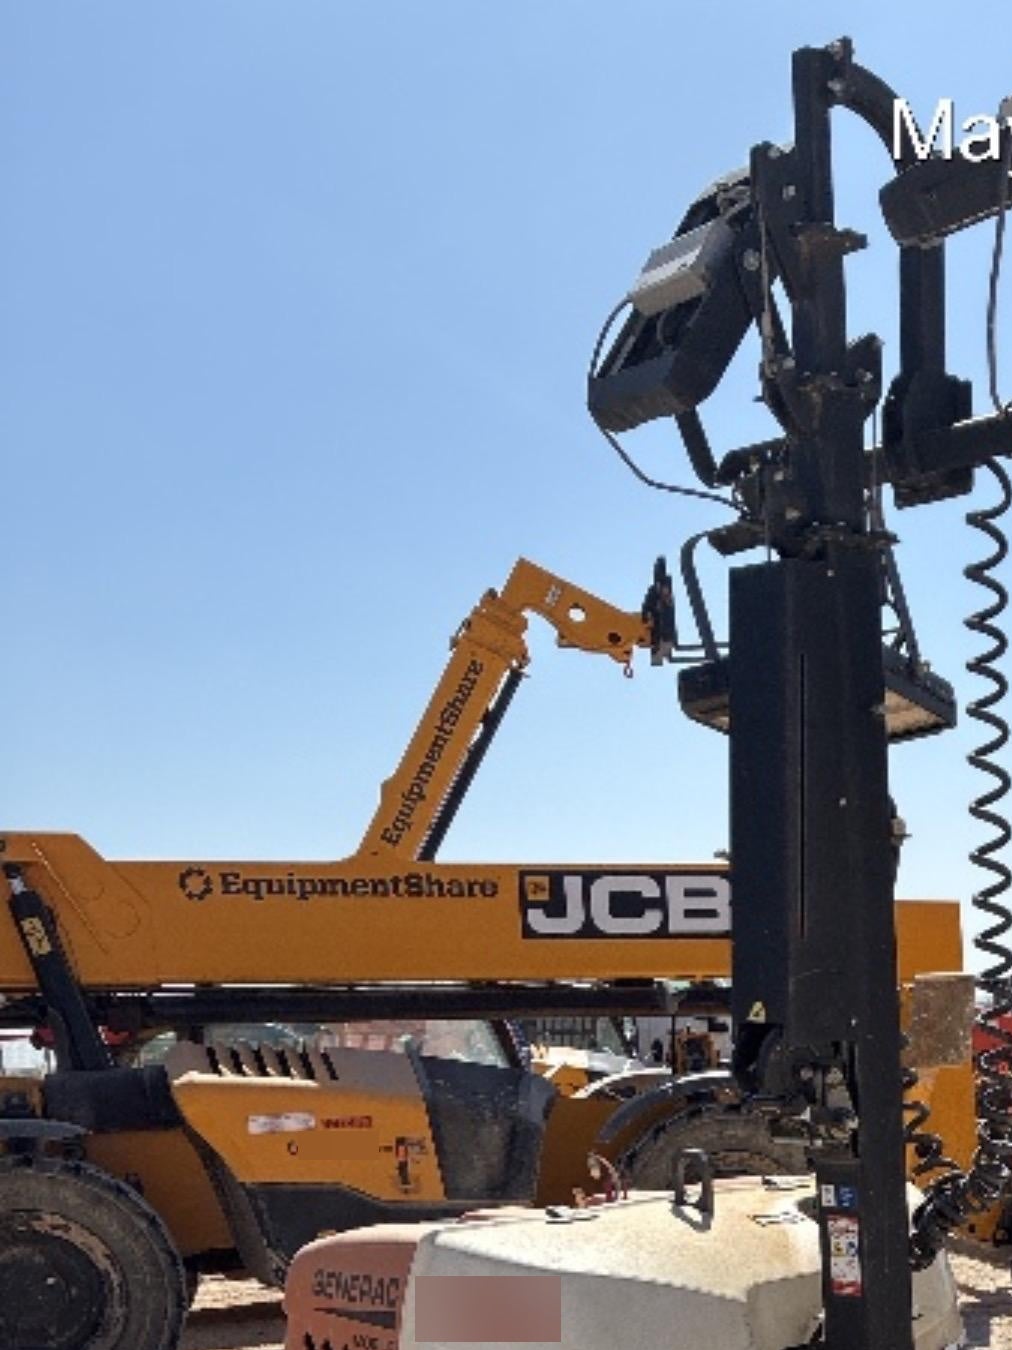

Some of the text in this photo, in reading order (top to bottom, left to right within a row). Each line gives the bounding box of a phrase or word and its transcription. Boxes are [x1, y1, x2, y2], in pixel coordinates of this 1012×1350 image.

[381, 659, 483, 846] EquipmentShare
[219, 872, 498, 900] EquipmentShare
[526, 874, 732, 934] JCB
[312, 1268, 400, 1308] GENERAC
